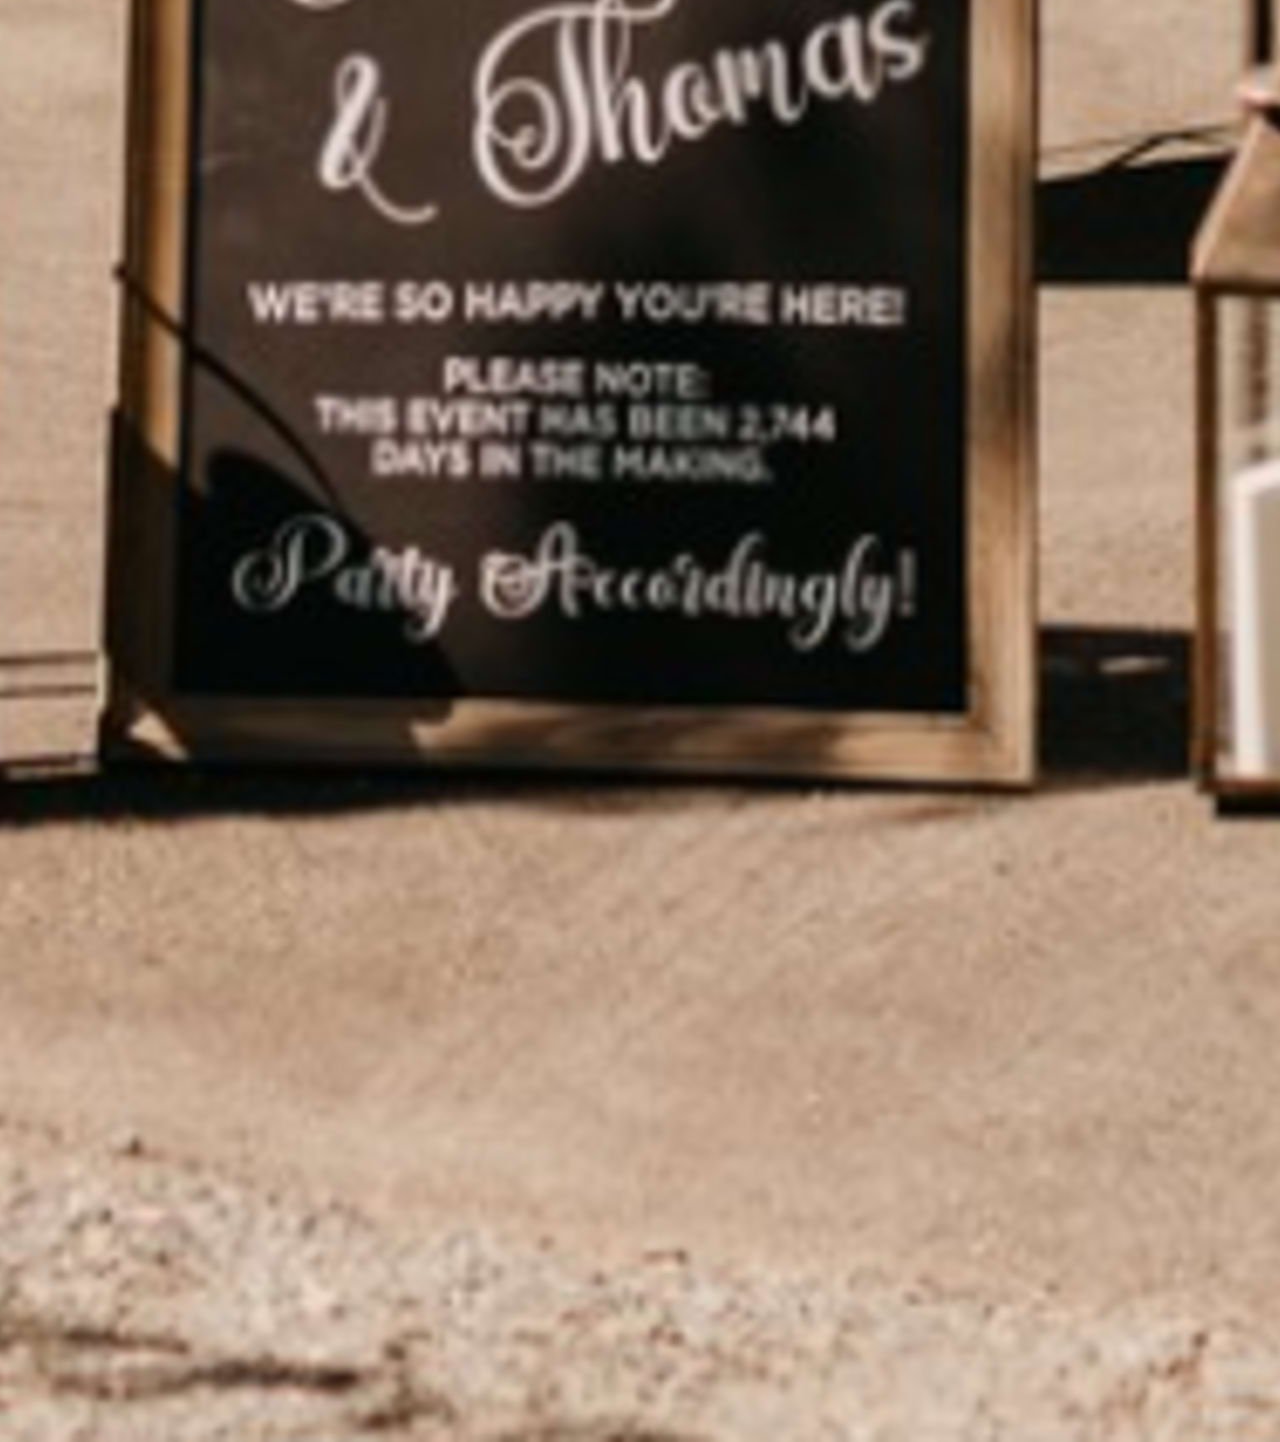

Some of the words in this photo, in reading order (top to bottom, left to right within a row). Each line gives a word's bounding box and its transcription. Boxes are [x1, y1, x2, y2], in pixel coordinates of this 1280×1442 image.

[319, 54, 439, 223] &
[247, 281, 382, 323] WE'RE
[394, 281, 454, 324] SO
[464, 281, 604, 324] HAPPY
[616, 282, 771, 324] YOU'RE
[779, 284, 906, 326] HERE!
[443, 356, 584, 394] PLEASE
[594, 361, 710, 399] NOTE:
[315, 395, 396, 435] THIS
[407, 397, 530, 435] EVENT
[539, 403, 617, 439] HAS
[628, 404, 726, 440] BEEN
[370, 438, 470, 478] DAYS
[479, 440, 520, 478] IN
[530, 443, 603, 482] THE
[232, 513, 457, 644] Party
[478, 520, 916, 653] Accordingly!
